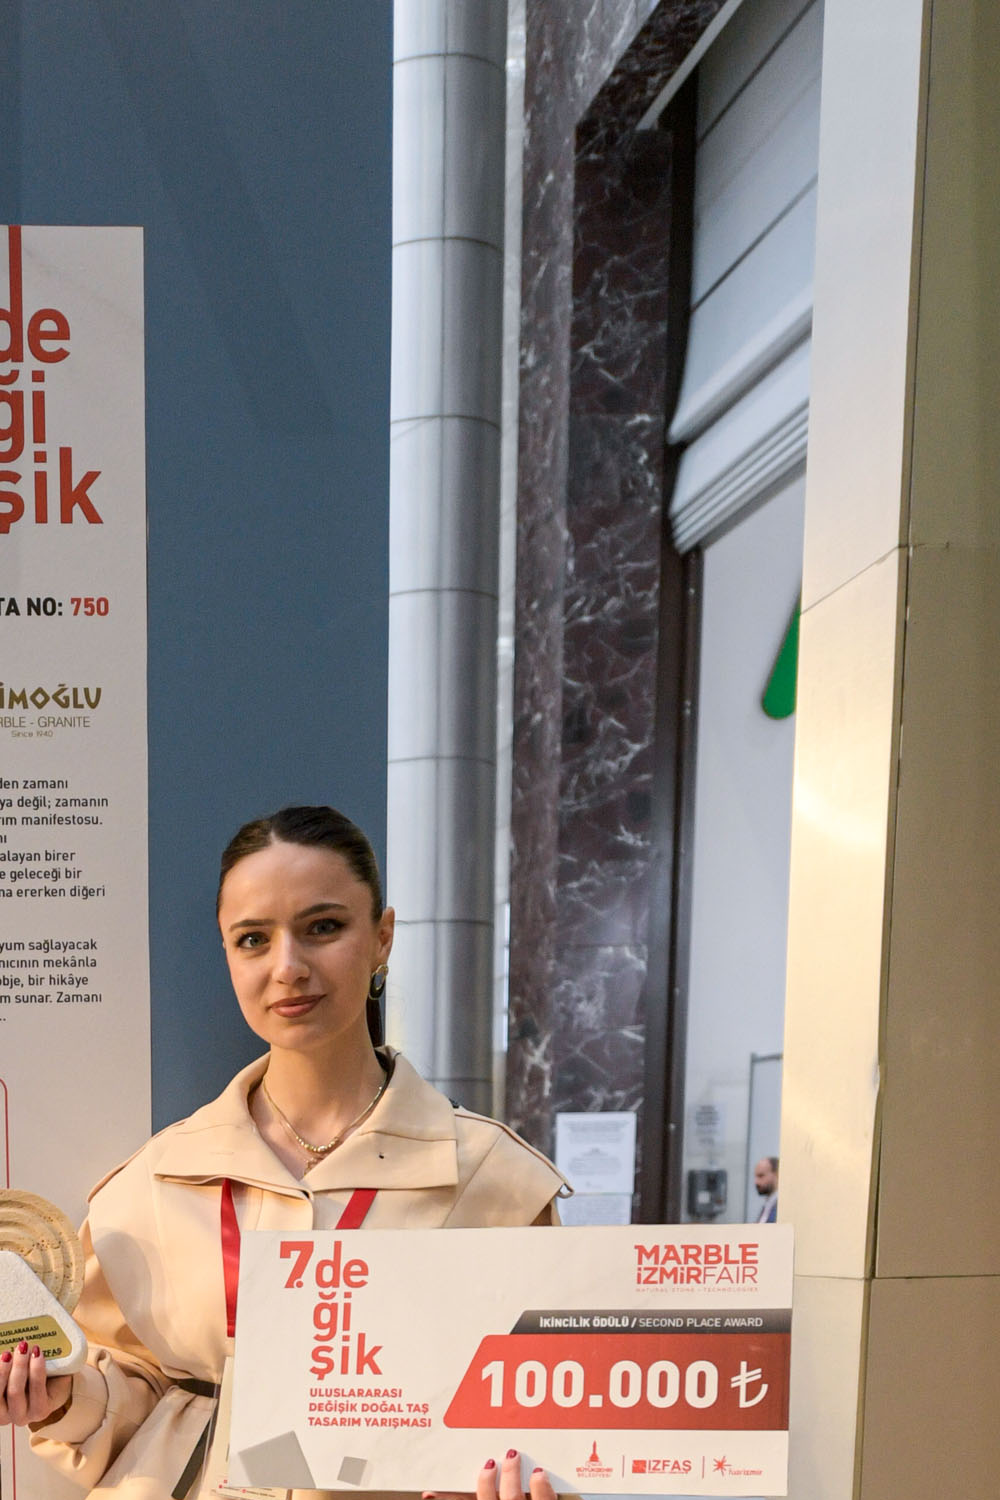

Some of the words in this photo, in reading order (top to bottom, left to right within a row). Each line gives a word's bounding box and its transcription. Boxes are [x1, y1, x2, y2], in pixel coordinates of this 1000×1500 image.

[27, 597, 63, 617] NO:
[70, 597, 110, 617] 750
[38, 716, 91, 728] GRANITE
[23, 780, 68, 789] zamanı
[17, 796, 51, 810] değil;
[55, 798, 108, 807] zamanın
[22, 814, 102, 825] manifestosu.
[45, 850, 76, 861] birer
[28, 938, 97, 953] sağlayacak
[634, 1244, 759, 1265] MARBLE
[315, 1240, 369, 1288] de
[313, 1291, 352, 1342] ği
[540, 1316, 590, 1328] İKİNCİLİK
[593, 1316, 629, 1328] ÖDÜLÜ
[639, 1317, 683, 1328] SECOND
[687, 1317, 721, 1328] PLACE
[724, 1316, 763, 1327] AWARD
[309, 1333, 384, 1380] şik
[481, 1360, 718, 1408] 100.000
[310, 1388, 402, 1398] ULUSLARARASI
[308, 1400, 357, 1414] DEĞİŞİK
[361, 1401, 403, 1412] DOĞAL
[407, 1403, 429, 1415] TAŞ
[308, 1417, 361, 1427] TASARIM
[365, 1417, 431, 1429] YARIŞMASI
